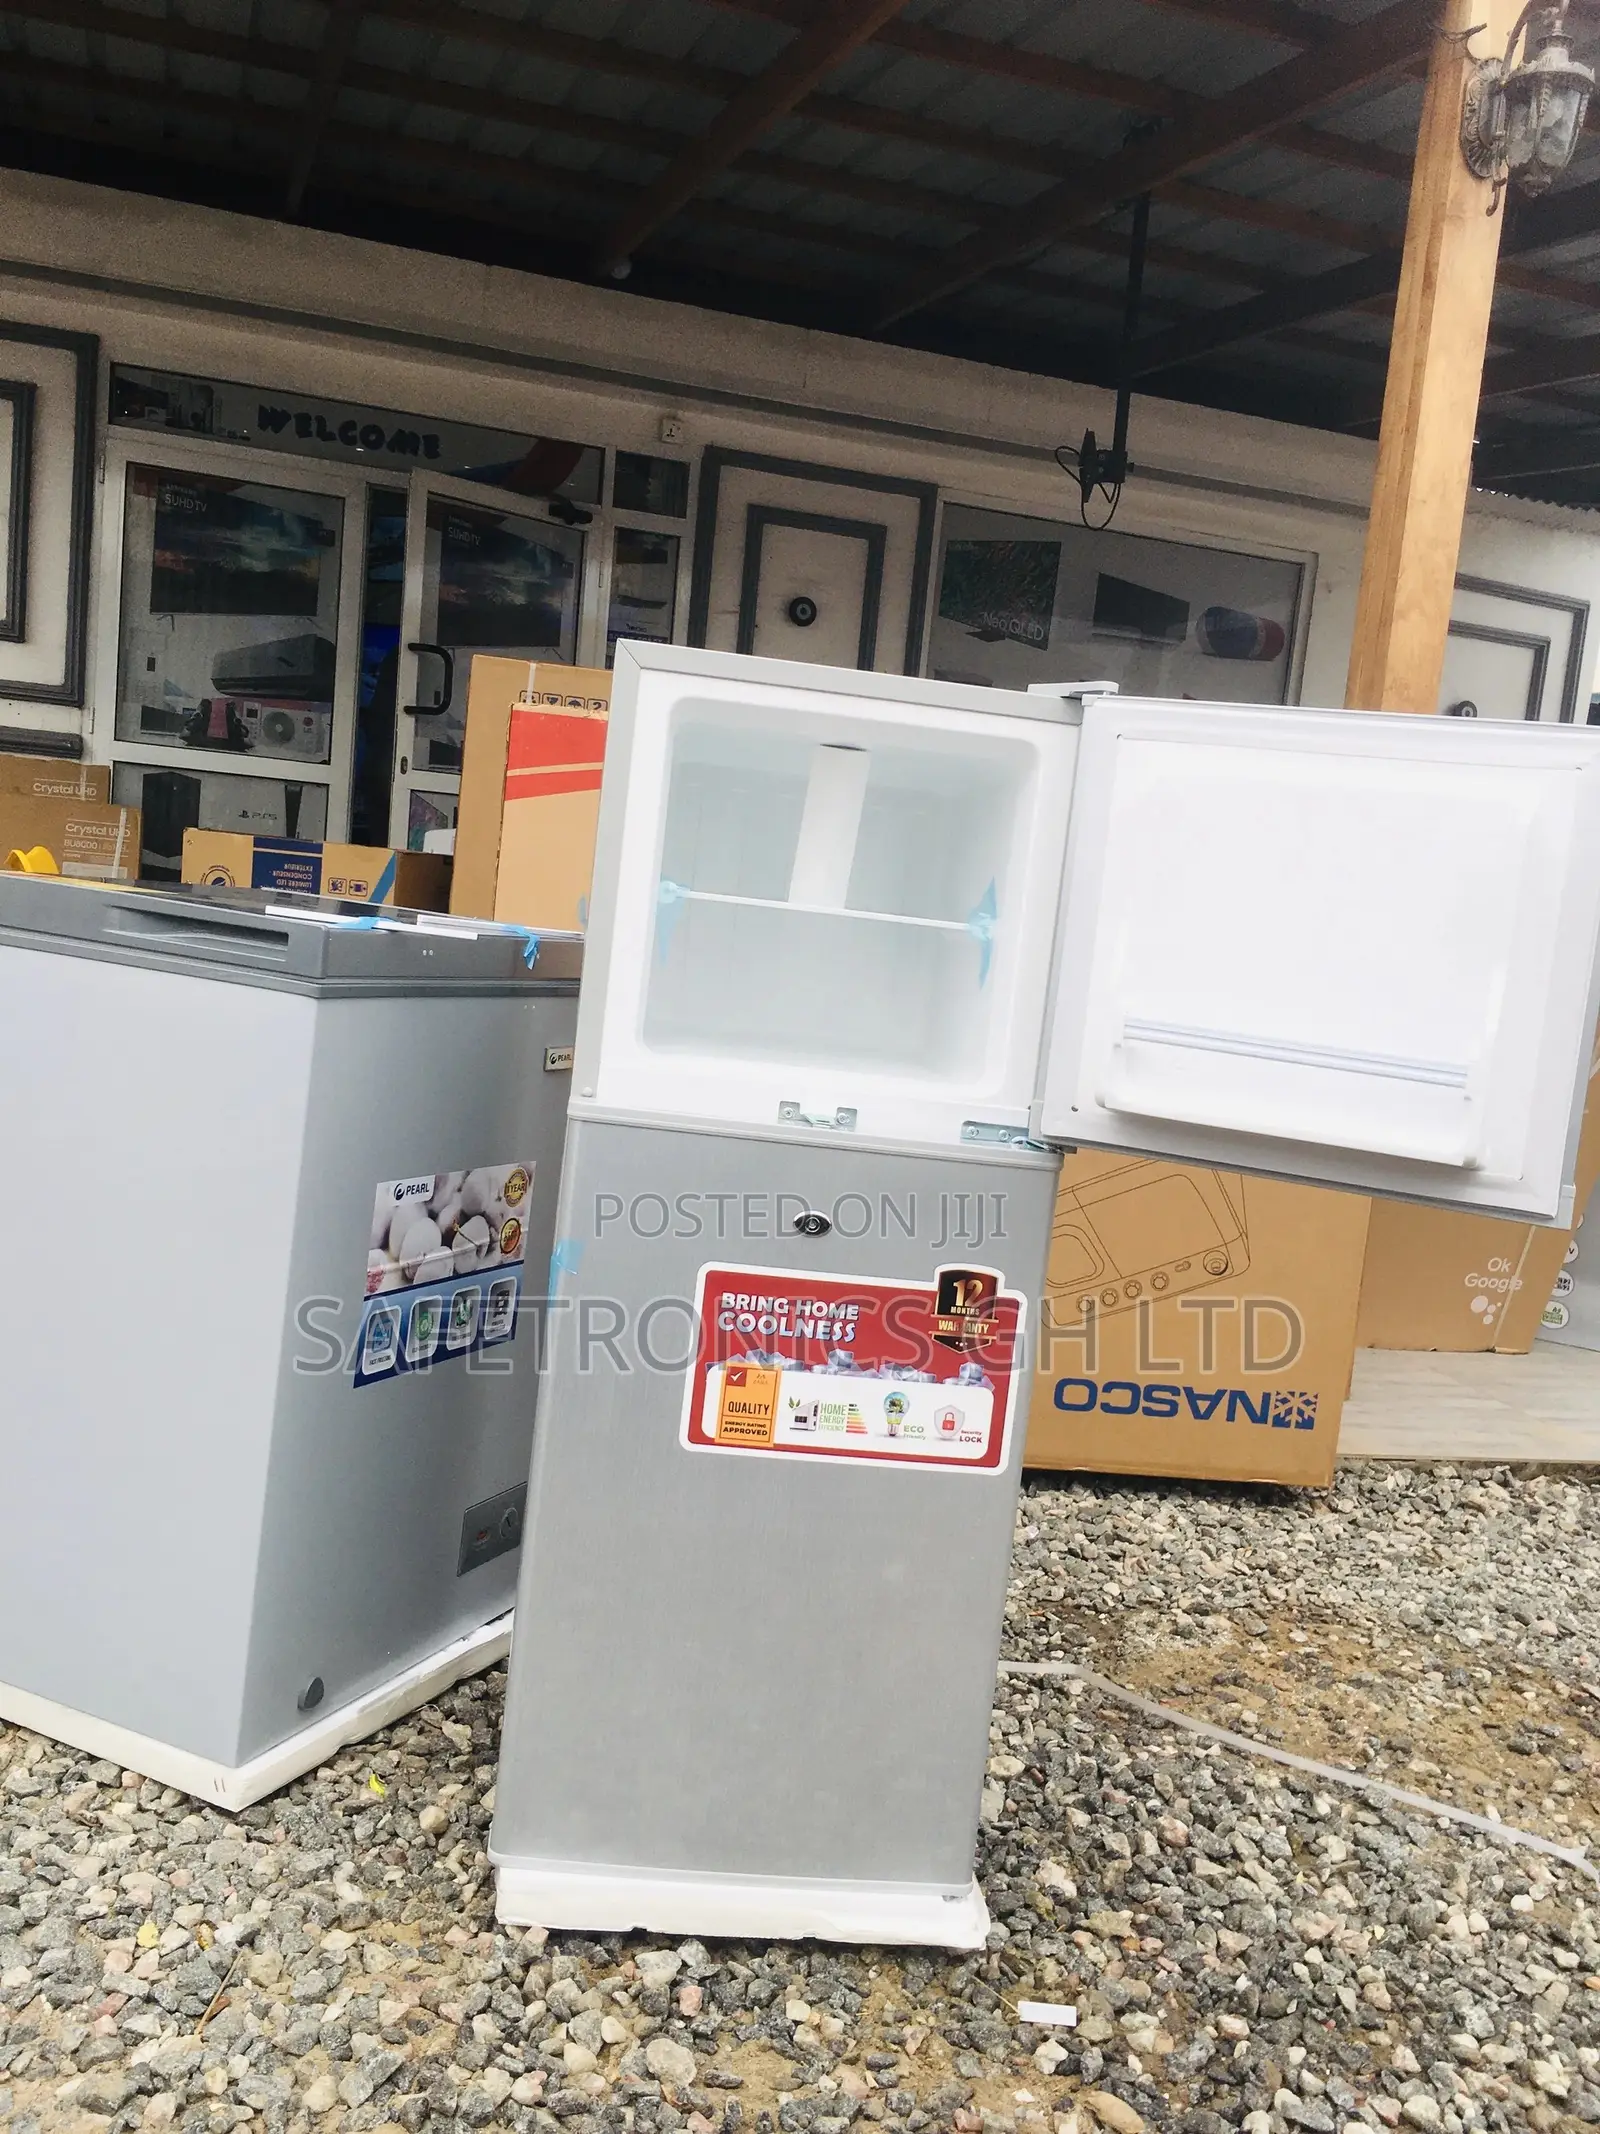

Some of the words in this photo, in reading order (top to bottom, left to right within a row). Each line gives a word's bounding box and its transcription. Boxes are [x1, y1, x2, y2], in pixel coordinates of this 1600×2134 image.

[257, 404, 441, 460] WELCOME
[33, 782, 74, 795] Crystal
[65, 823, 107, 836] Crystal
[405, 1182, 430, 1196] PEARL
[1487, 1256, 1513, 1273] Ok
[953, 1279, 983, 1307] 12
[720, 1291, 789, 1314] BRING
[795, 1299, 860, 1321] HOME
[950, 1306, 980, 1316] MONTHS
[717, 1309, 856, 1343] COOLNESS
[728, 1400, 770, 1416] QUALITY
[1053, 1377, 1272, 1425] NASCO
[820, 1402, 847, 1416] HOME
[724, 1420, 746, 1428] ENERGY
[747, 1421, 767, 1429] RATING
[819, 1414, 845, 1425] ENERGY
[722, 1426, 768, 1437] APPROVED
[903, 1425, 925, 1433] ECO
[959, 1435, 983, 1443] LOCK
